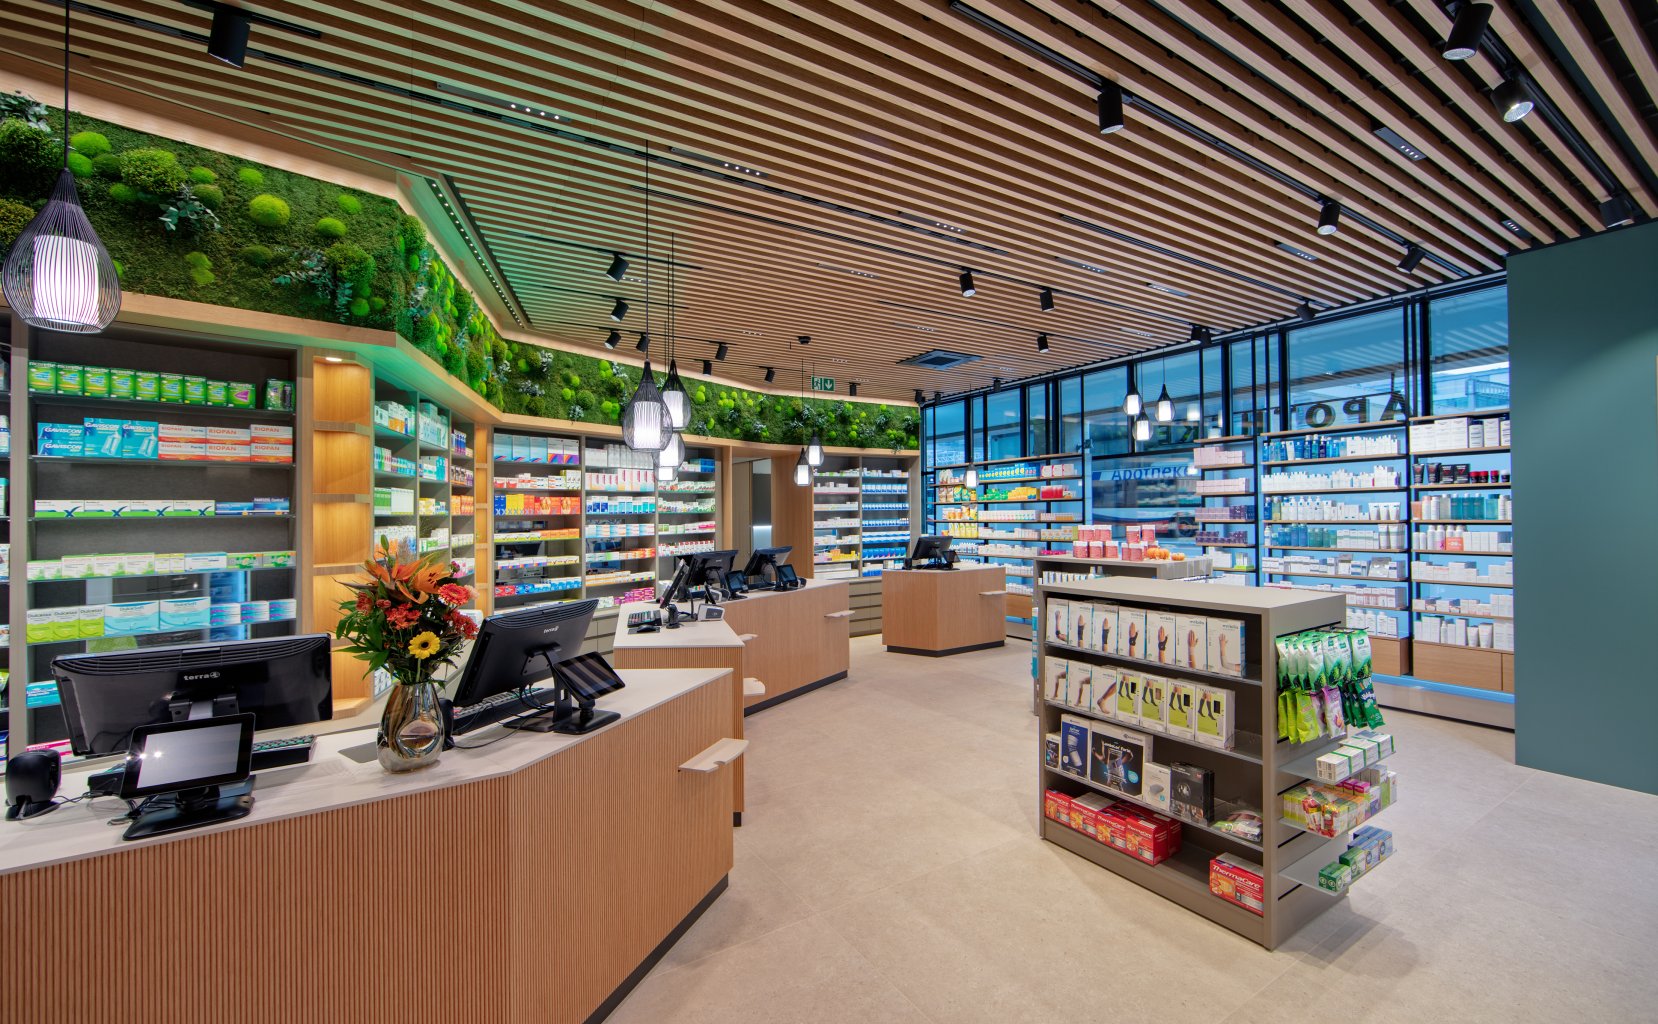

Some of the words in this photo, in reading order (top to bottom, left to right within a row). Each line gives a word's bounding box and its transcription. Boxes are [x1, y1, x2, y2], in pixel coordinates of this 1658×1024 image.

[84, 422, 120, 430] GAVISCON
[122, 424, 156, 433] GAVISCON
[44, 427, 82, 435] GAVISCON
[44, 443, 82, 451] GAVISCON
[1071, 803, 1096, 818] ThermaCare
[1097, 815, 1126, 830] ThermaCare
[1212, 864, 1261, 889] ThermaCare
